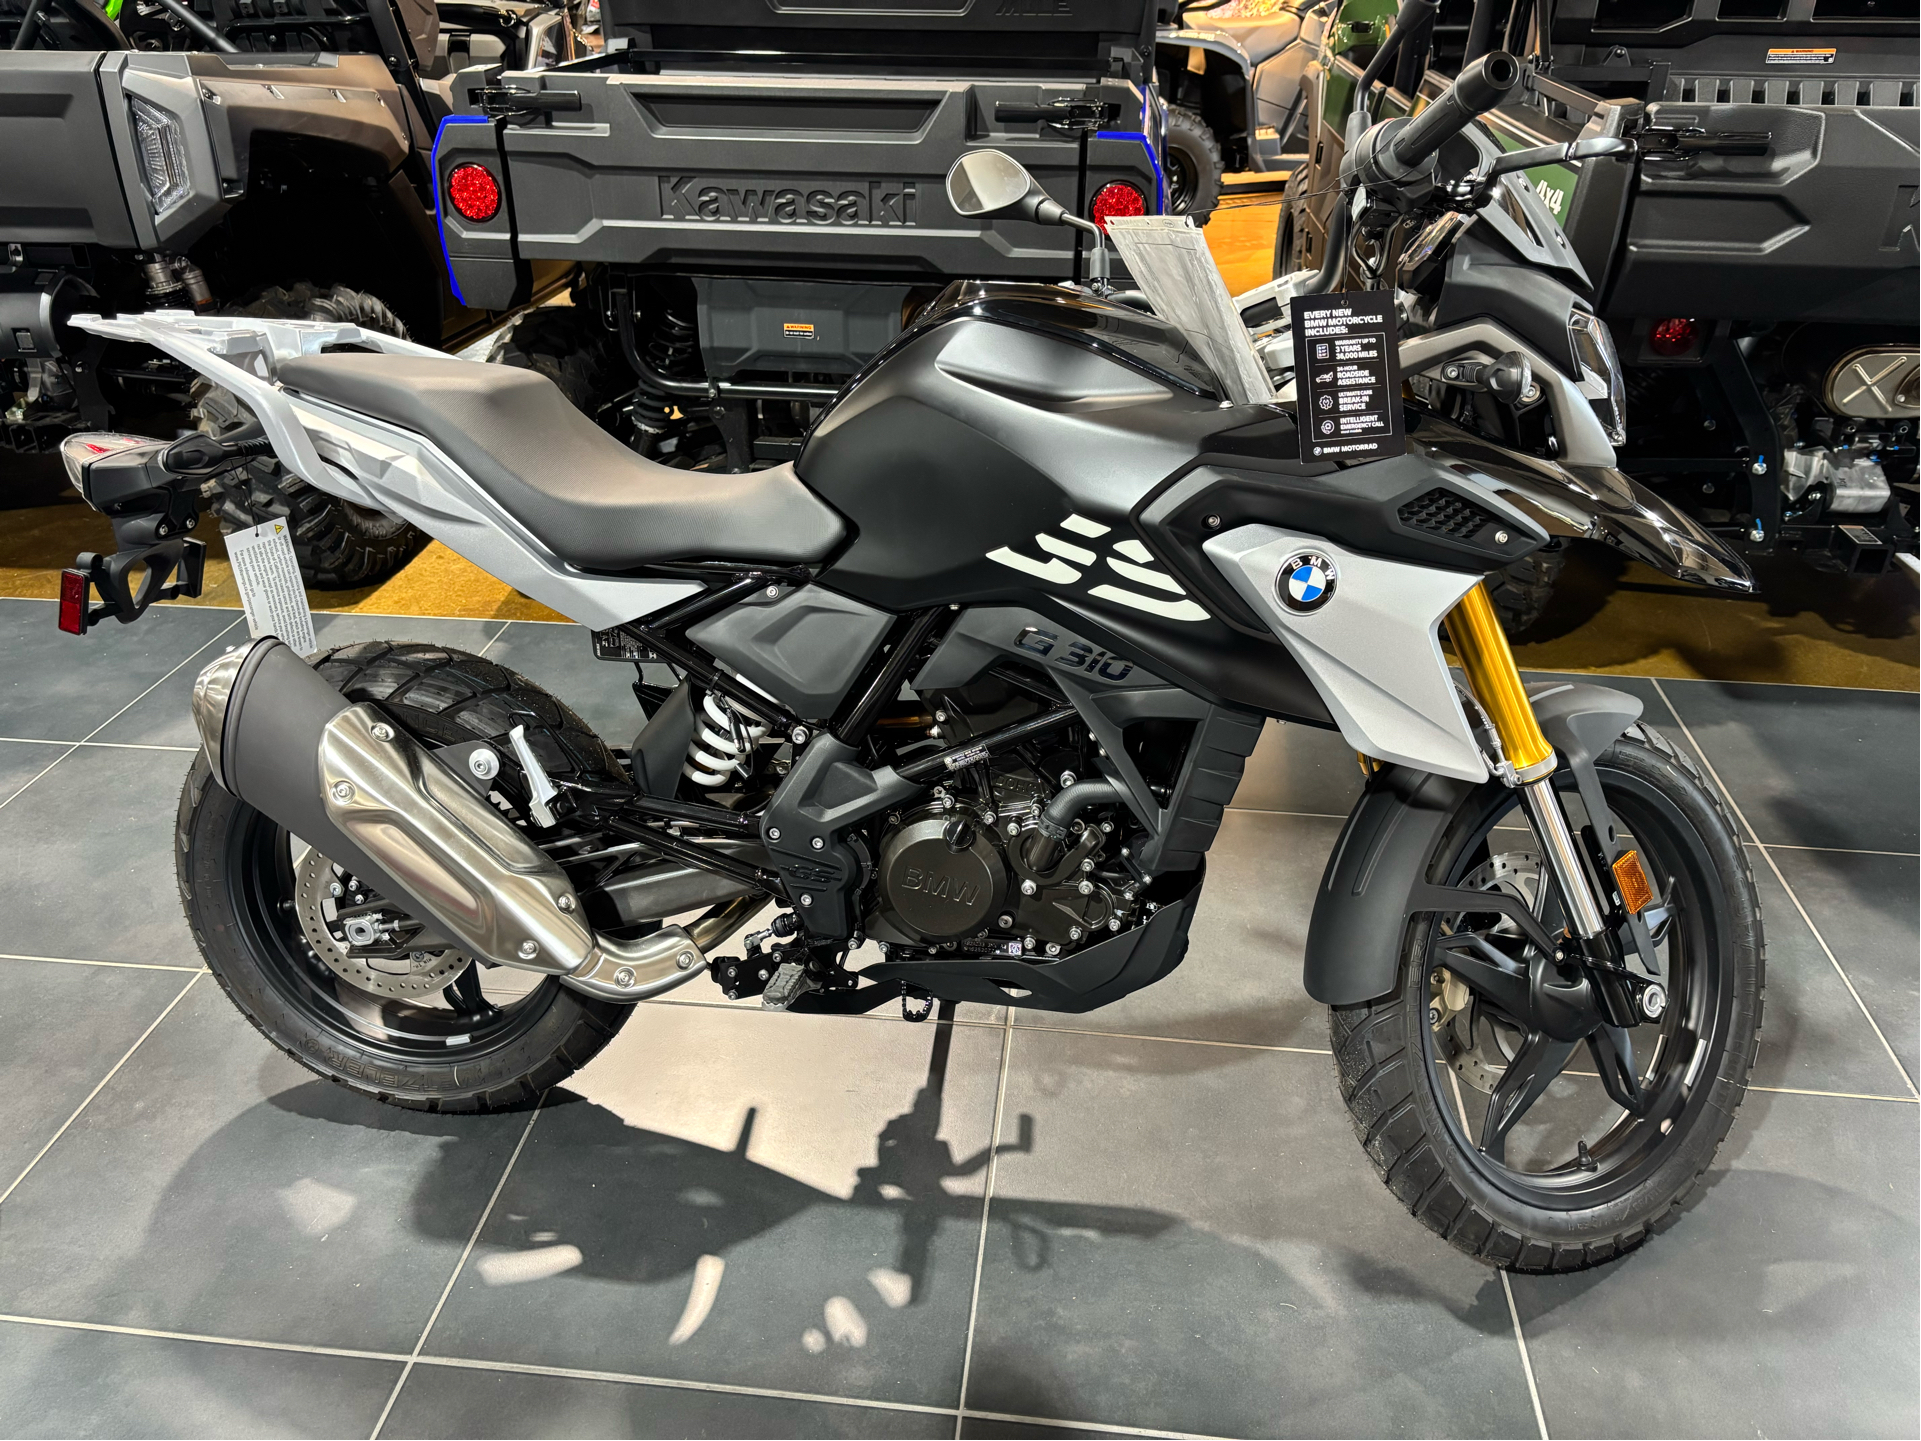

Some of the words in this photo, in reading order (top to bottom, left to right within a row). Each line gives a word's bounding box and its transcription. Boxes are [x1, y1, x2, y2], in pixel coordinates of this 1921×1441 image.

[657, 175, 917, 226] Kawasaki
[1536, 180, 1565, 215] 4x4
[1304, 310, 1331, 320] EVERY
[1332, 308, 1352, 316] NEW
[1304, 319, 1328, 328] BMW
[1328, 315, 1383, 326] MOTORCYCLE
[1305, 326, 1348, 336] INCLUDES:
[1341, 344, 1362, 352] YEARS
[1358, 350, 1378, 358] MILES
[1337, 370, 1370, 378] ROADSIDE
[1338, 376, 1376, 386] ASSISTANCE
[1339, 396, 1370, 404] BREAK-IN
[1339, 402, 1366, 411] SERVICE
[1340, 415, 1378, 424] INTELLIGENT
[1323, 446, 1340, 454] BMW
[1341, 442, 1378, 452] MOTORRAD
[1290, 555, 1336, 580] BMW
[1014, 626, 1059, 657] G
[1054, 641, 1134, 682] 310
[995, 775, 1038, 796] DOHC
[901, 865, 981, 906] BMW
